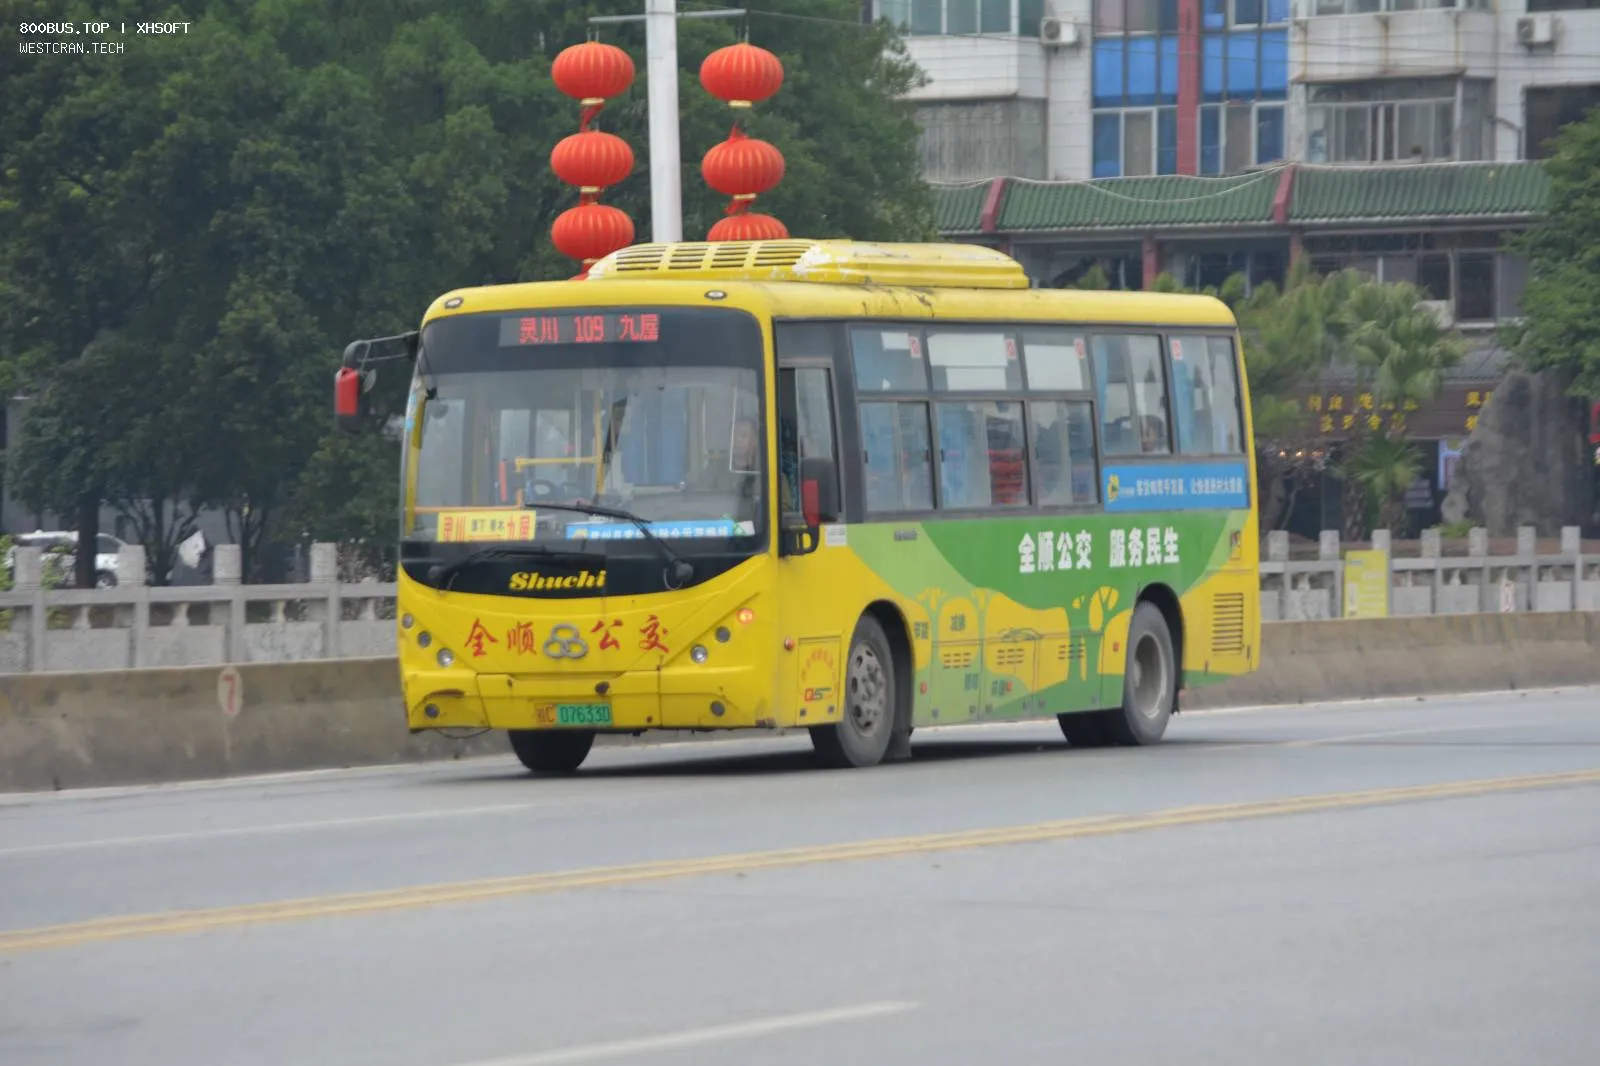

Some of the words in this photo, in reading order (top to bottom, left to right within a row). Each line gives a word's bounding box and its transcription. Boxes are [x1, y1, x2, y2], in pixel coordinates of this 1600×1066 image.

[519, 315, 559, 344] 灵川
[574, 315, 604, 343] 109
[1018, 529, 1092, 574] 全顺公交
[1109, 525, 1180, 568] 服务民生
[509, 569, 607, 591] Shuchi
[464, 617, 538, 658] 全顺
[590, 614, 670, 654] 公交
